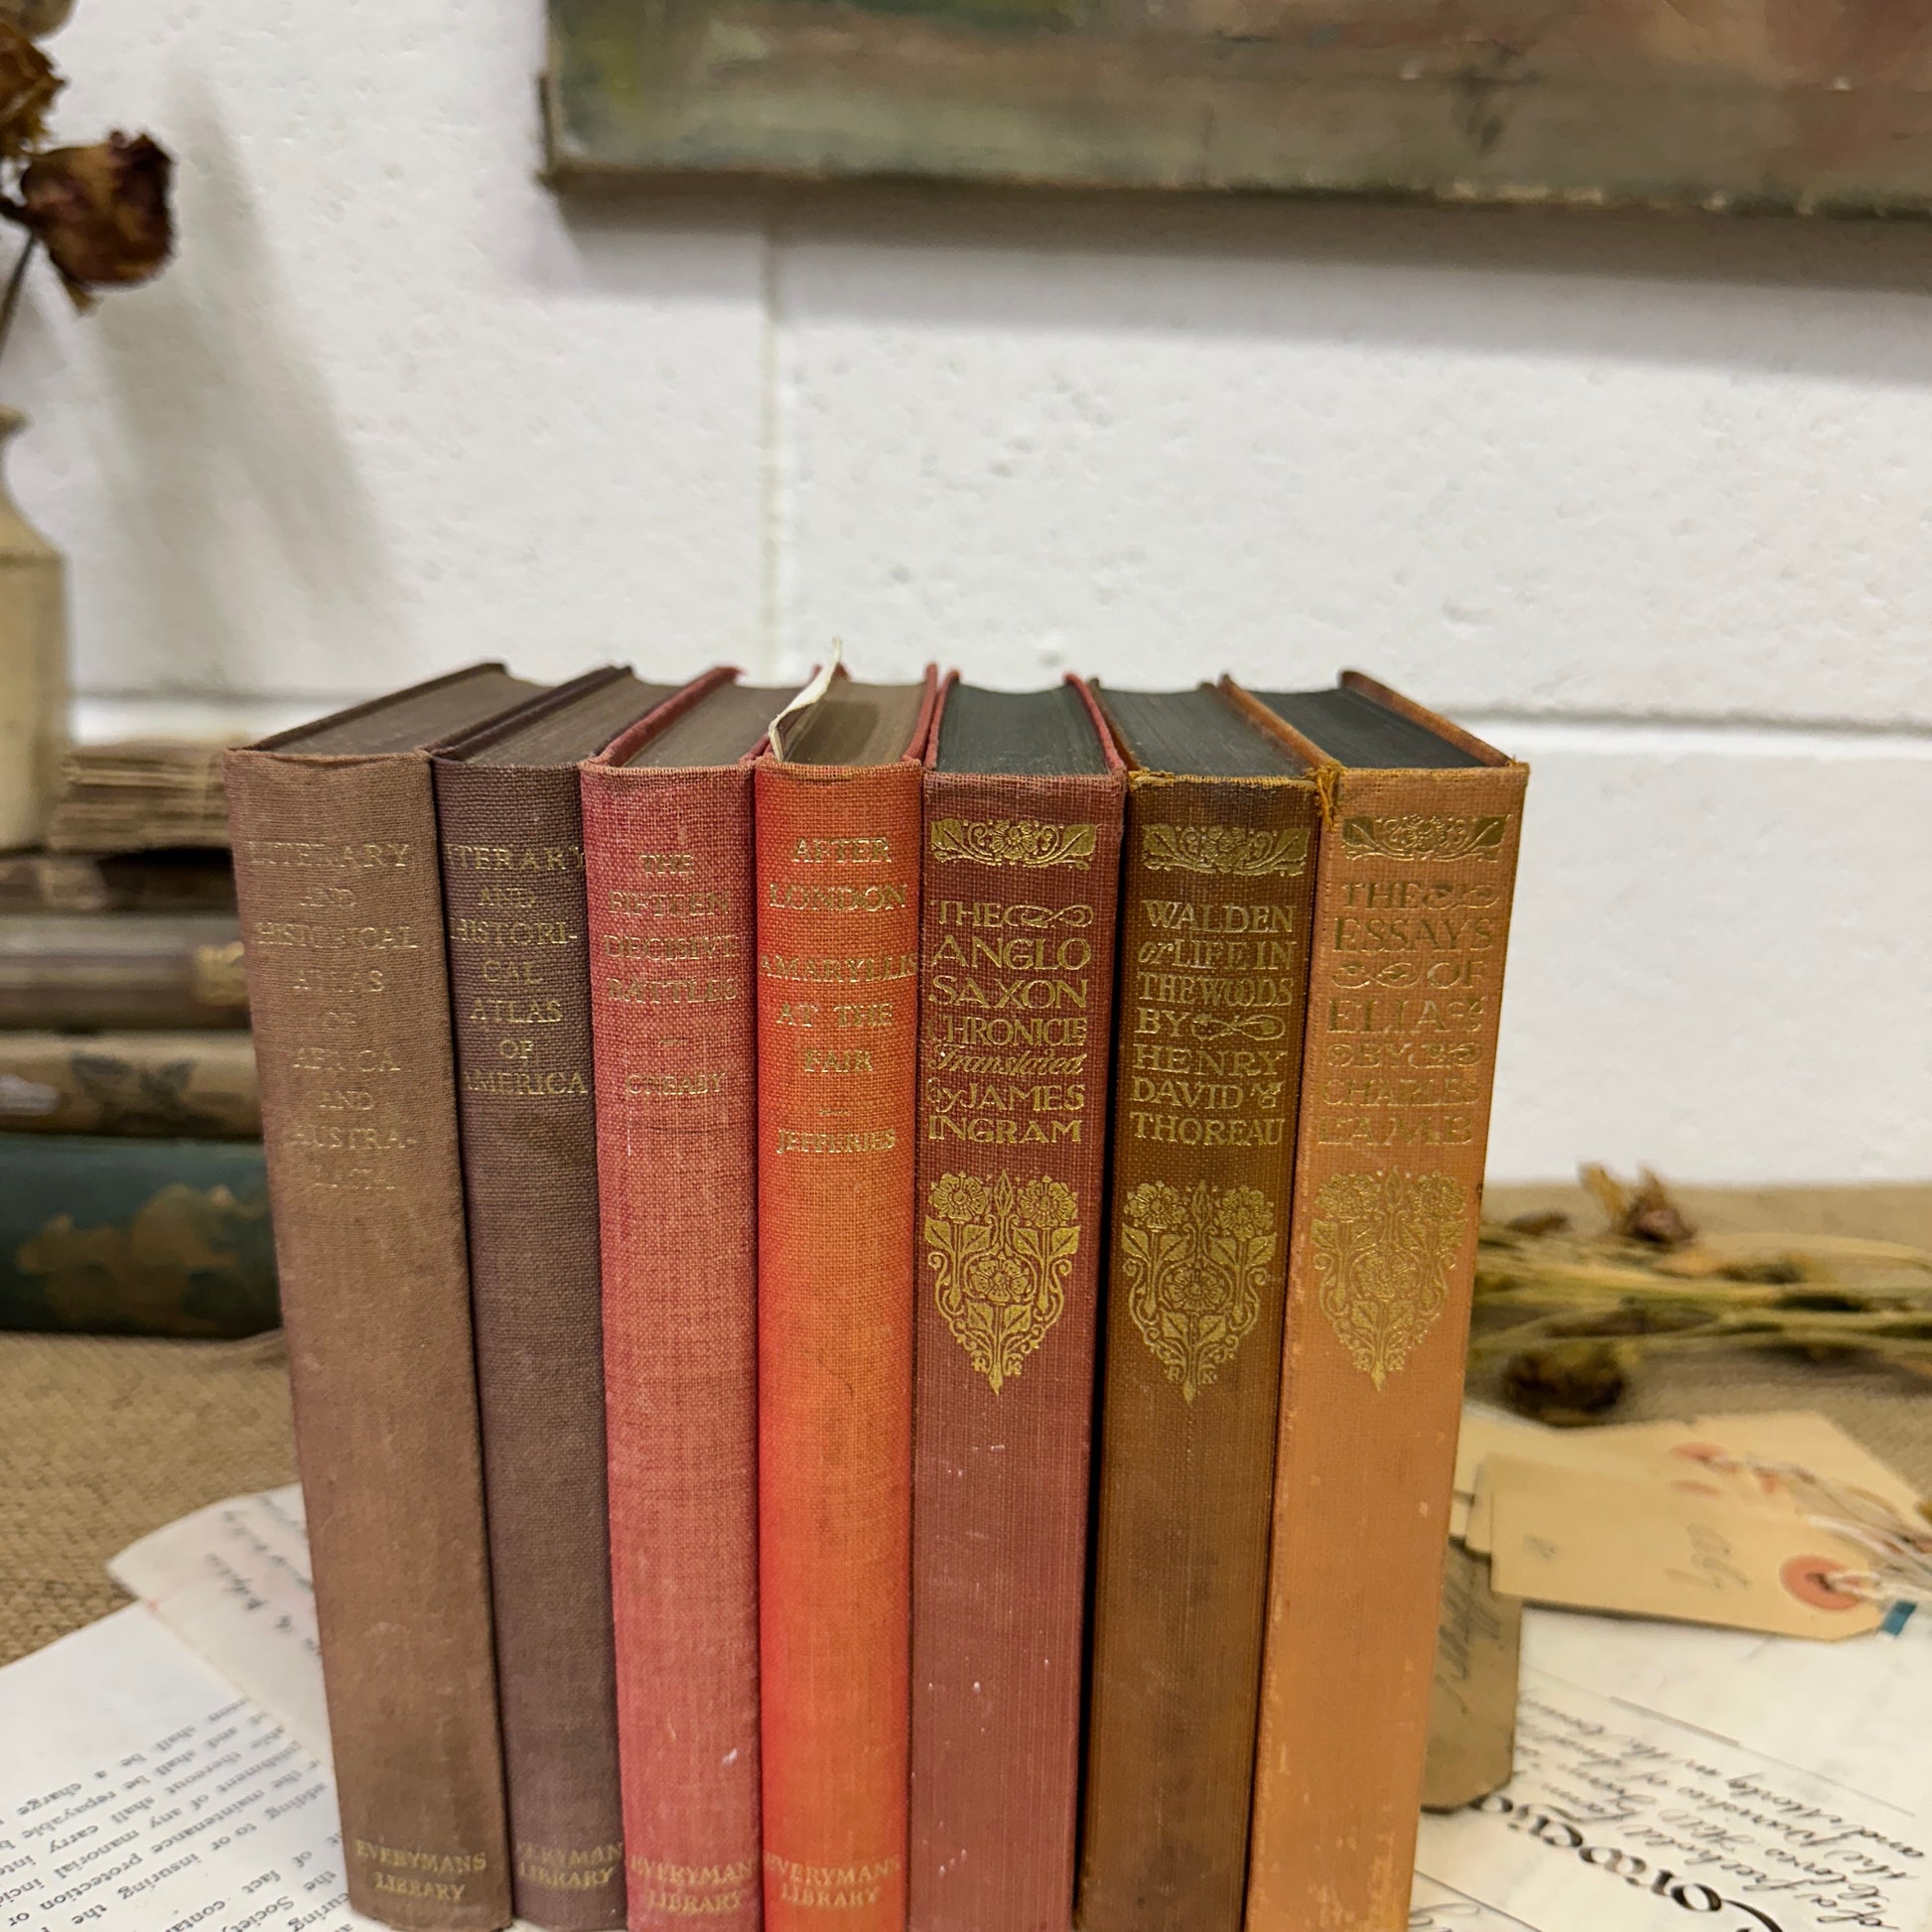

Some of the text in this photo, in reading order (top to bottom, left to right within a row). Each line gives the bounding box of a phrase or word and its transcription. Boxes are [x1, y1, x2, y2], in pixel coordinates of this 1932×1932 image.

[792, 837, 893, 863] AFTER
[768, 884, 907, 912] LONDON
[1341, 882, 1422, 910] THE
[928, 898, 1003, 929] THE
[1142, 898, 1298, 933] WALDEN
[1331, 915, 1493, 953] ESSAYS
[931, 934, 1092, 971] ANGLO
[1138, 938, 1298, 970] or LIFE IN
[483, 960, 543, 984] CAL
[1427, 961, 1488, 989] OF
[927, 974, 1089, 1010] SAXON
[1137, 970, 1294, 1007] THE WOODS
[469, 999, 563, 1024] ATLAS
[775, 1002, 893, 1028] AT THE
[1134, 1007, 1191, 1037] BY
[1326, 998, 1451, 1035] ELIA
[499, 1040, 533, 1059] OF
[804, 1048, 874, 1073] FAIR
[926, 1042, 1088, 1076] Translated
[1132, 1043, 1289, 1076] HENRY
[959, 1082, 1086, 1112] JAMES
[1129, 1075, 1244, 1110] DAVID
[928, 1115, 1083, 1144] INGRAM
[1129, 1111, 1286, 1146] THOREAU
[119, 1753, 148, 1767] be
[154, 1749, 197, 1775] shall
[123, 1775, 151, 1790] be
[16, 1783, 82, 1816] charge
[111, 1796, 155, 1824] shall
[22, 1791, 116, 1839] repayable
[150, 1807, 184, 1829] any
[151, 1789, 265, 1855] maintenance
[234, 1822, 258, 1836] to
[50, 1825, 99, 1854] carry
[54, 1830, 140, 1878] manorial
[210, 1836, 231, 1851] or
[291, 1851, 313, 1867] of
[40, 1853, 143, 1910] protection
[117, 1853, 202, 1900] insuring
[241, 1869, 282, 1893] fact
[303, 1870, 337, 1891] the
[8, 1912, 30, 1927] or
[71, 1904, 107, 1924] the
